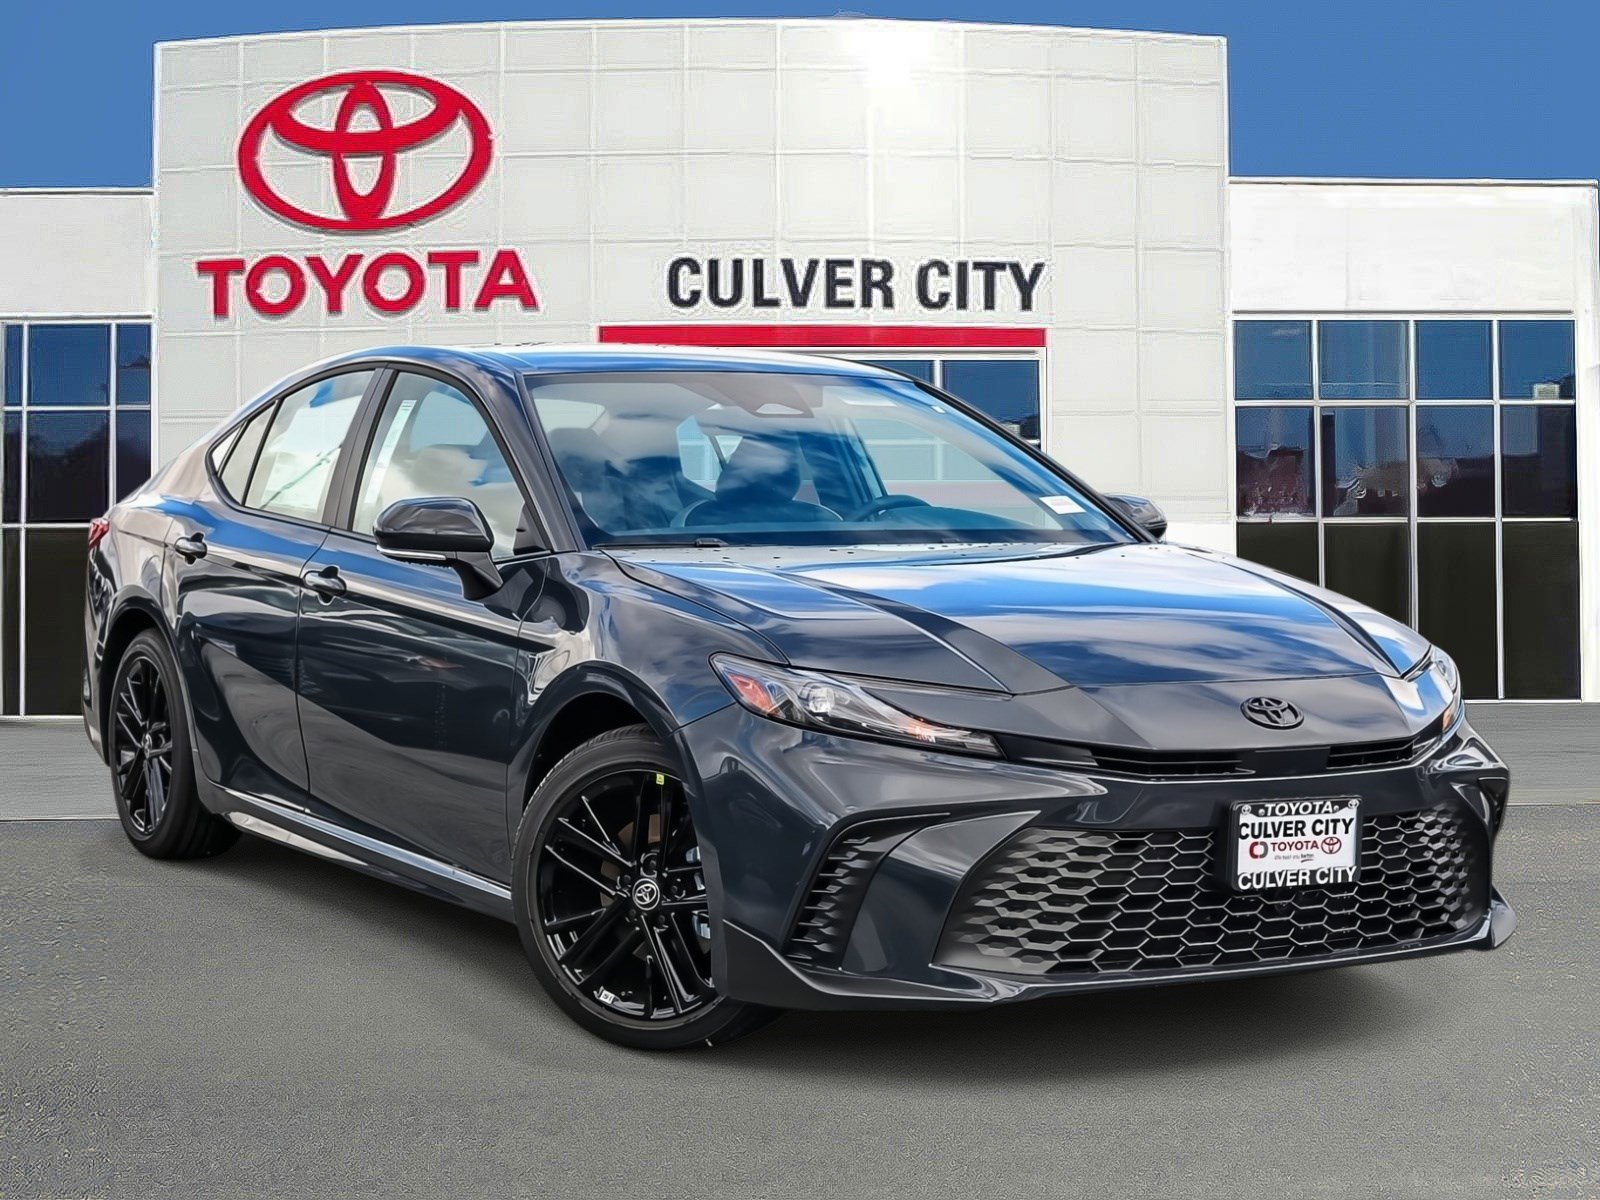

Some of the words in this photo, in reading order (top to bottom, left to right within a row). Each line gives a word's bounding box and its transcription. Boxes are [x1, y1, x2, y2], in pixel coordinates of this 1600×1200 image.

[197, 249, 538, 317] TOYOTA
[667, 256, 894, 309] CULVER
[916, 259, 1046, 311] CITY
[1265, 801, 1333, 816] TOYOTA
[1239, 820, 1306, 840] CULVER
[1312, 818, 1354, 836] CITY
[1271, 840, 1319, 852] TOYOTA
[1238, 869, 1311, 890] CULVER
[1316, 866, 1357, 885] CITY
